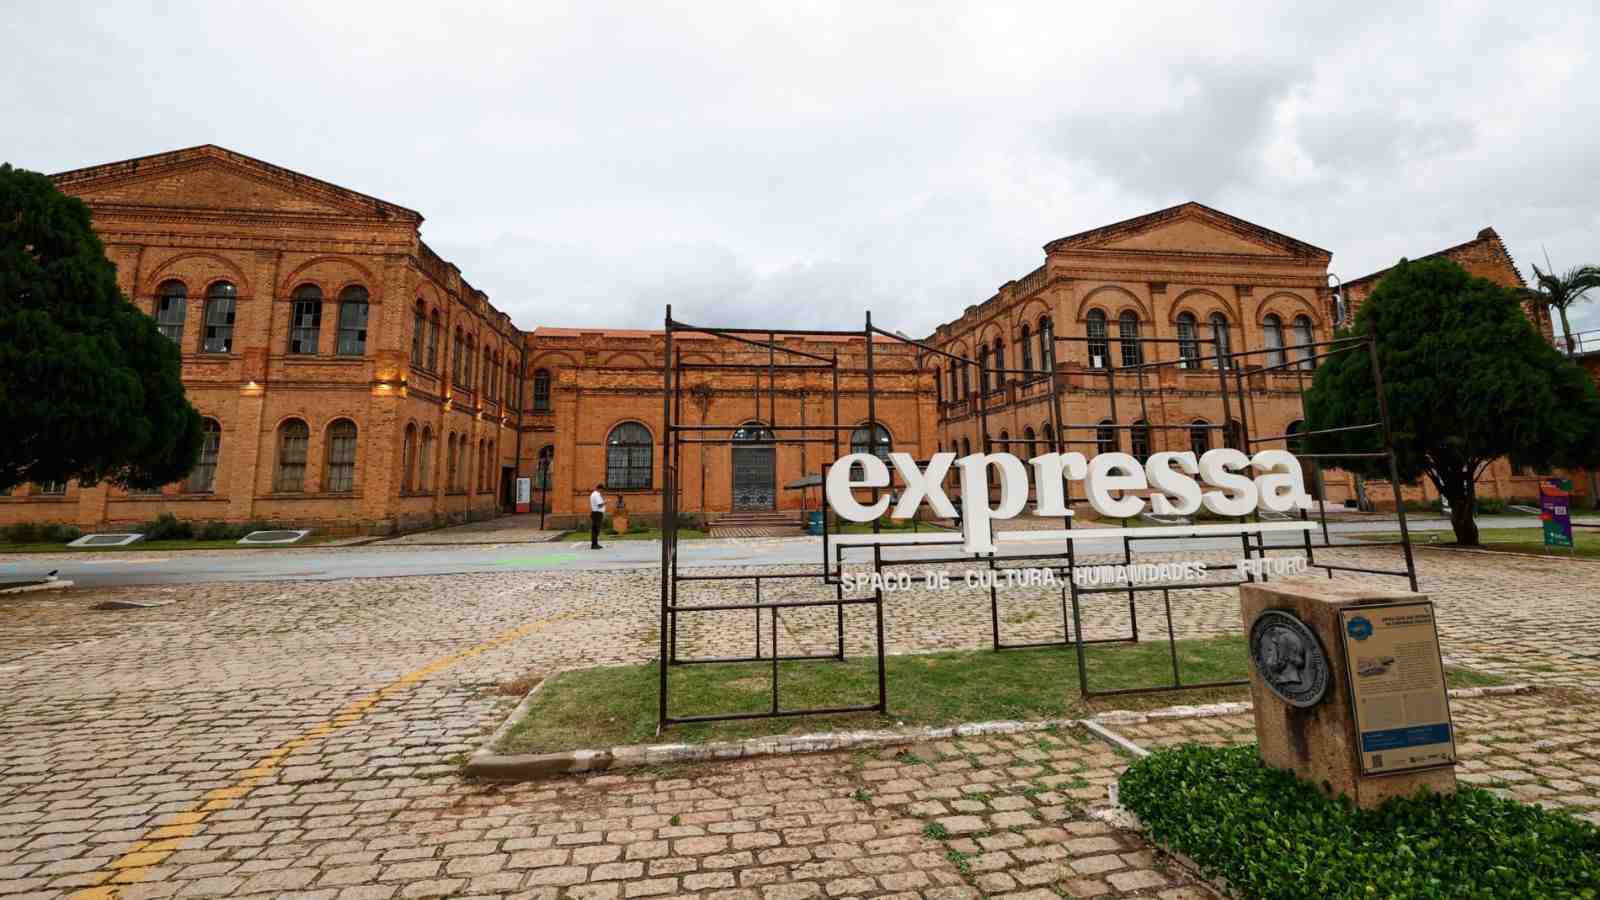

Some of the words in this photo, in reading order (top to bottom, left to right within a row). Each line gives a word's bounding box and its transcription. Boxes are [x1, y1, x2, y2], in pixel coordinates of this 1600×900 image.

[825, 448, 1313, 553] expressa
[926, 570, 950, 591] DE
[1073, 561, 1207, 585] HUMANIDADES
[1239, 556, 1307, 580] FUTURO
